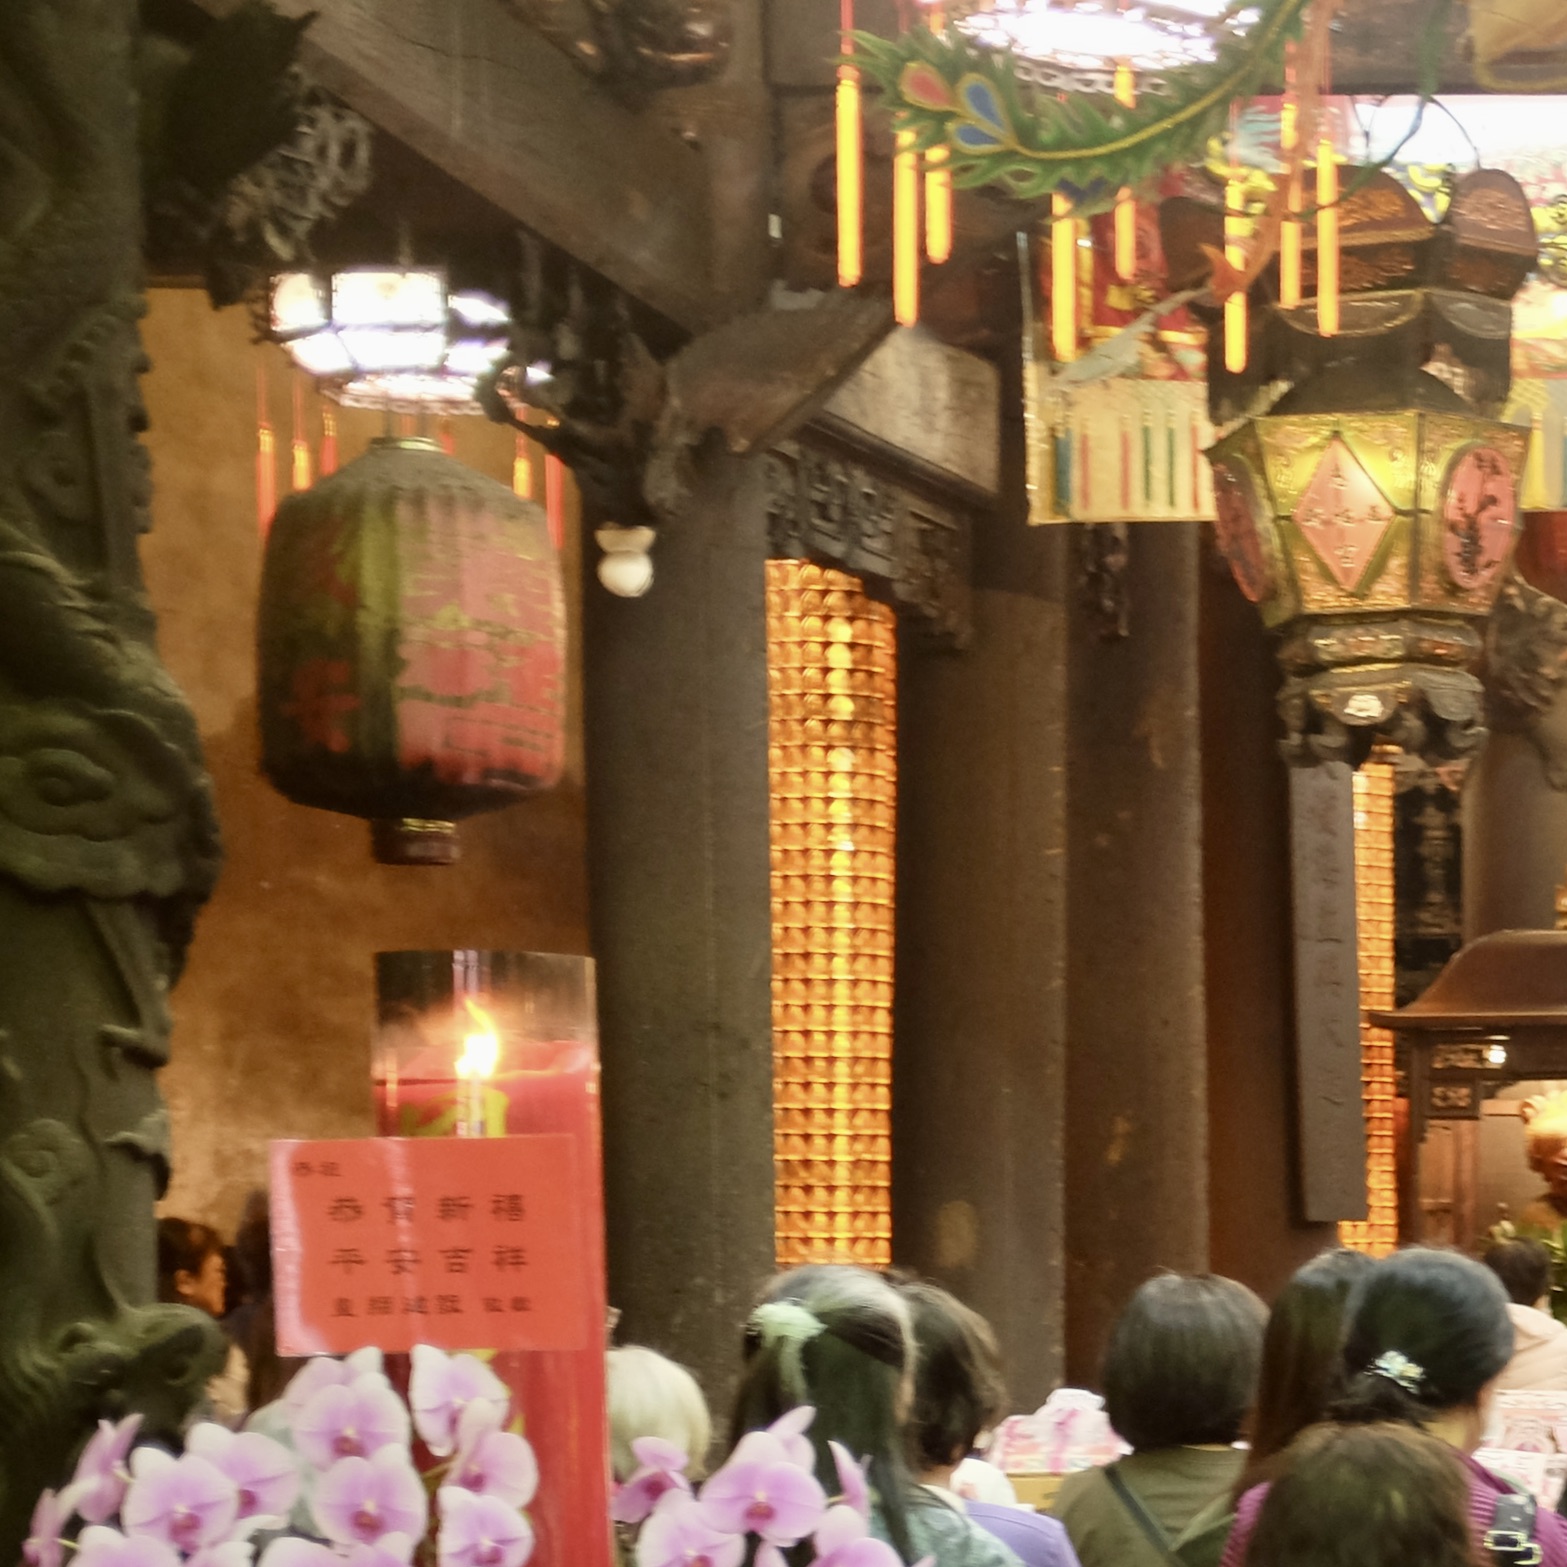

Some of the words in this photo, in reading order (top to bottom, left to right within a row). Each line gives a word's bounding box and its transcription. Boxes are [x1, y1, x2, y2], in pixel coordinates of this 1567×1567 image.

[327, 1193, 526, 1222] 恭賀新禧
[329, 1245, 529, 1274] 平安吉祥
